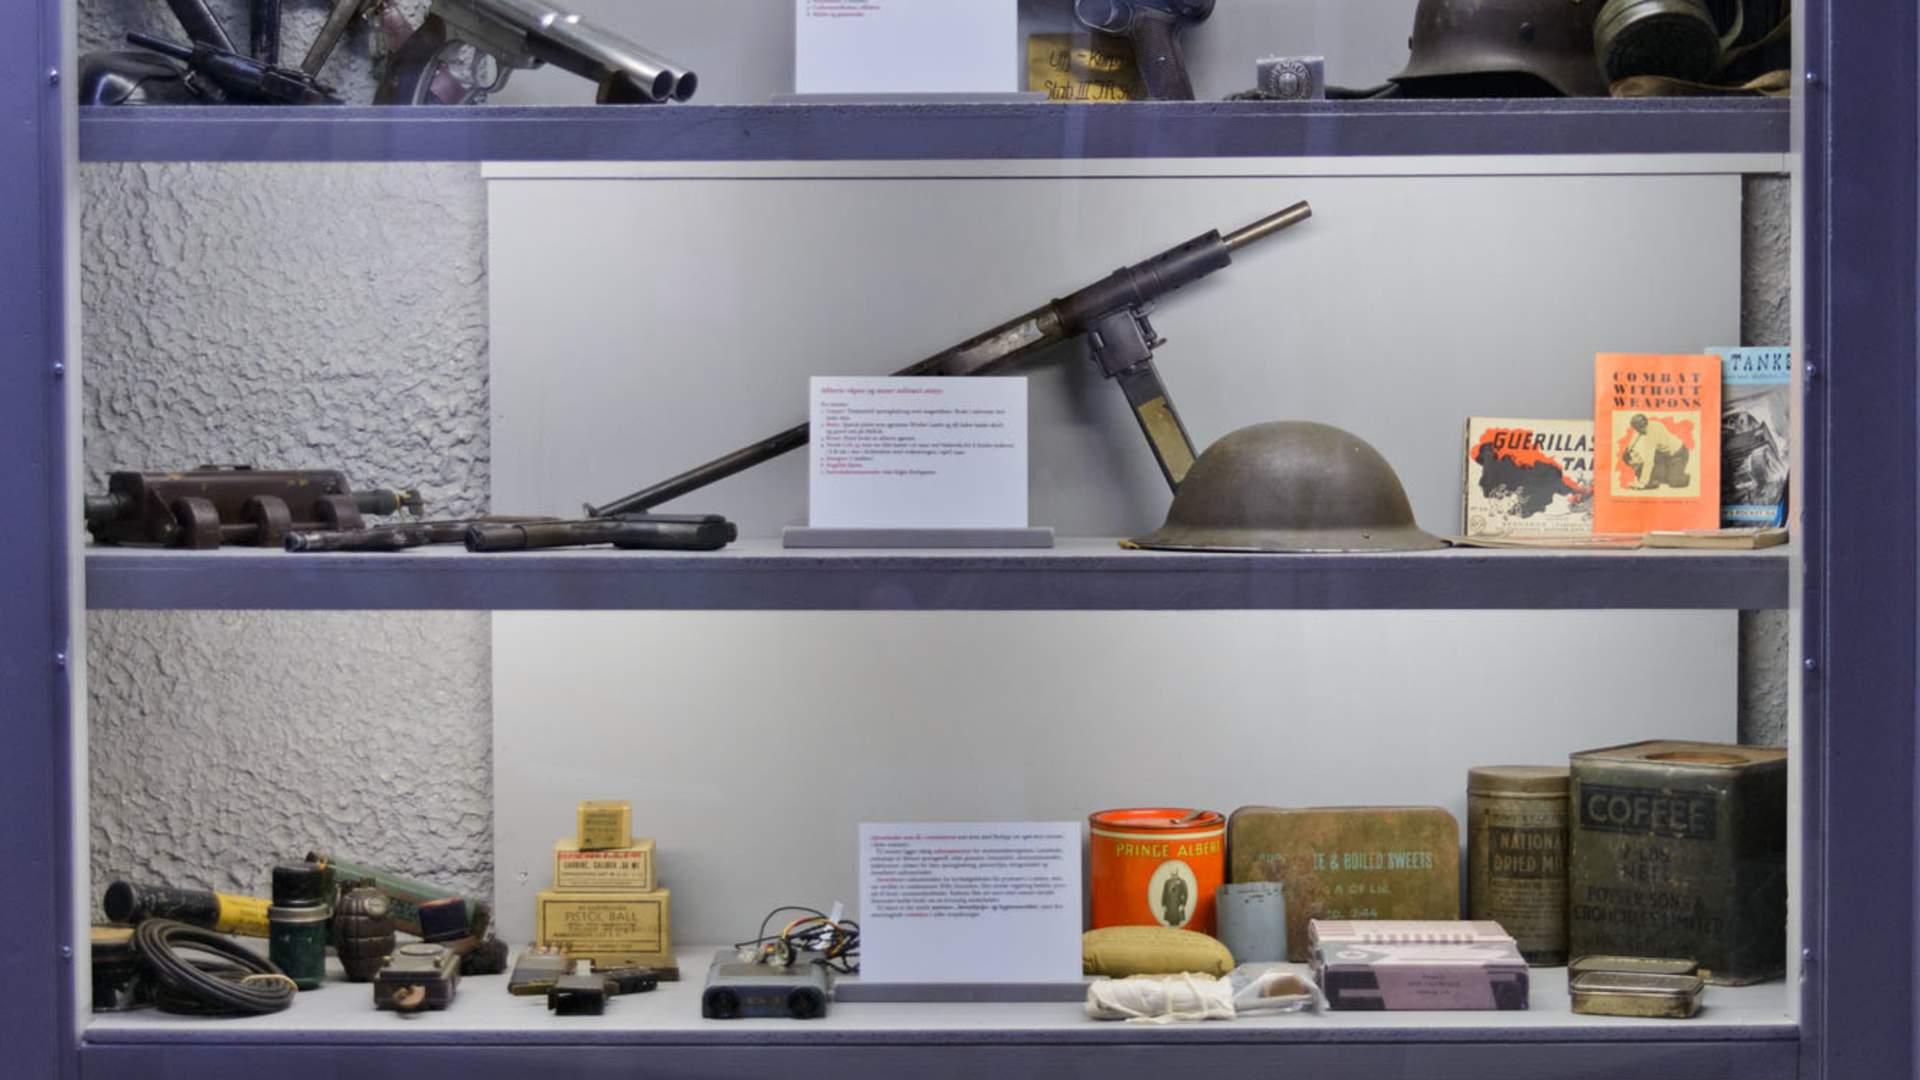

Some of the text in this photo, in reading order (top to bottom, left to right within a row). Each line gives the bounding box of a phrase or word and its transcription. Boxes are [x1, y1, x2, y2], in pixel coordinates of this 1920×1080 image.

[1612, 372, 1702, 384] COMBAT
[1613, 385, 1702, 396] WITHOUT
[1613, 396, 1702, 408] WEAPONS
[1586, 794, 1707, 834] COFFEE
[1115, 840, 1221, 858] PRINCE ALBERT
[1329, 853, 1340, 871] &
[1343, 852, 1383, 871] BOILED
[1386, 851, 1433, 870] SWEETS
[1494, 853, 1536, 873] DRIED
[565, 911, 638, 922] PISTOL BALL
